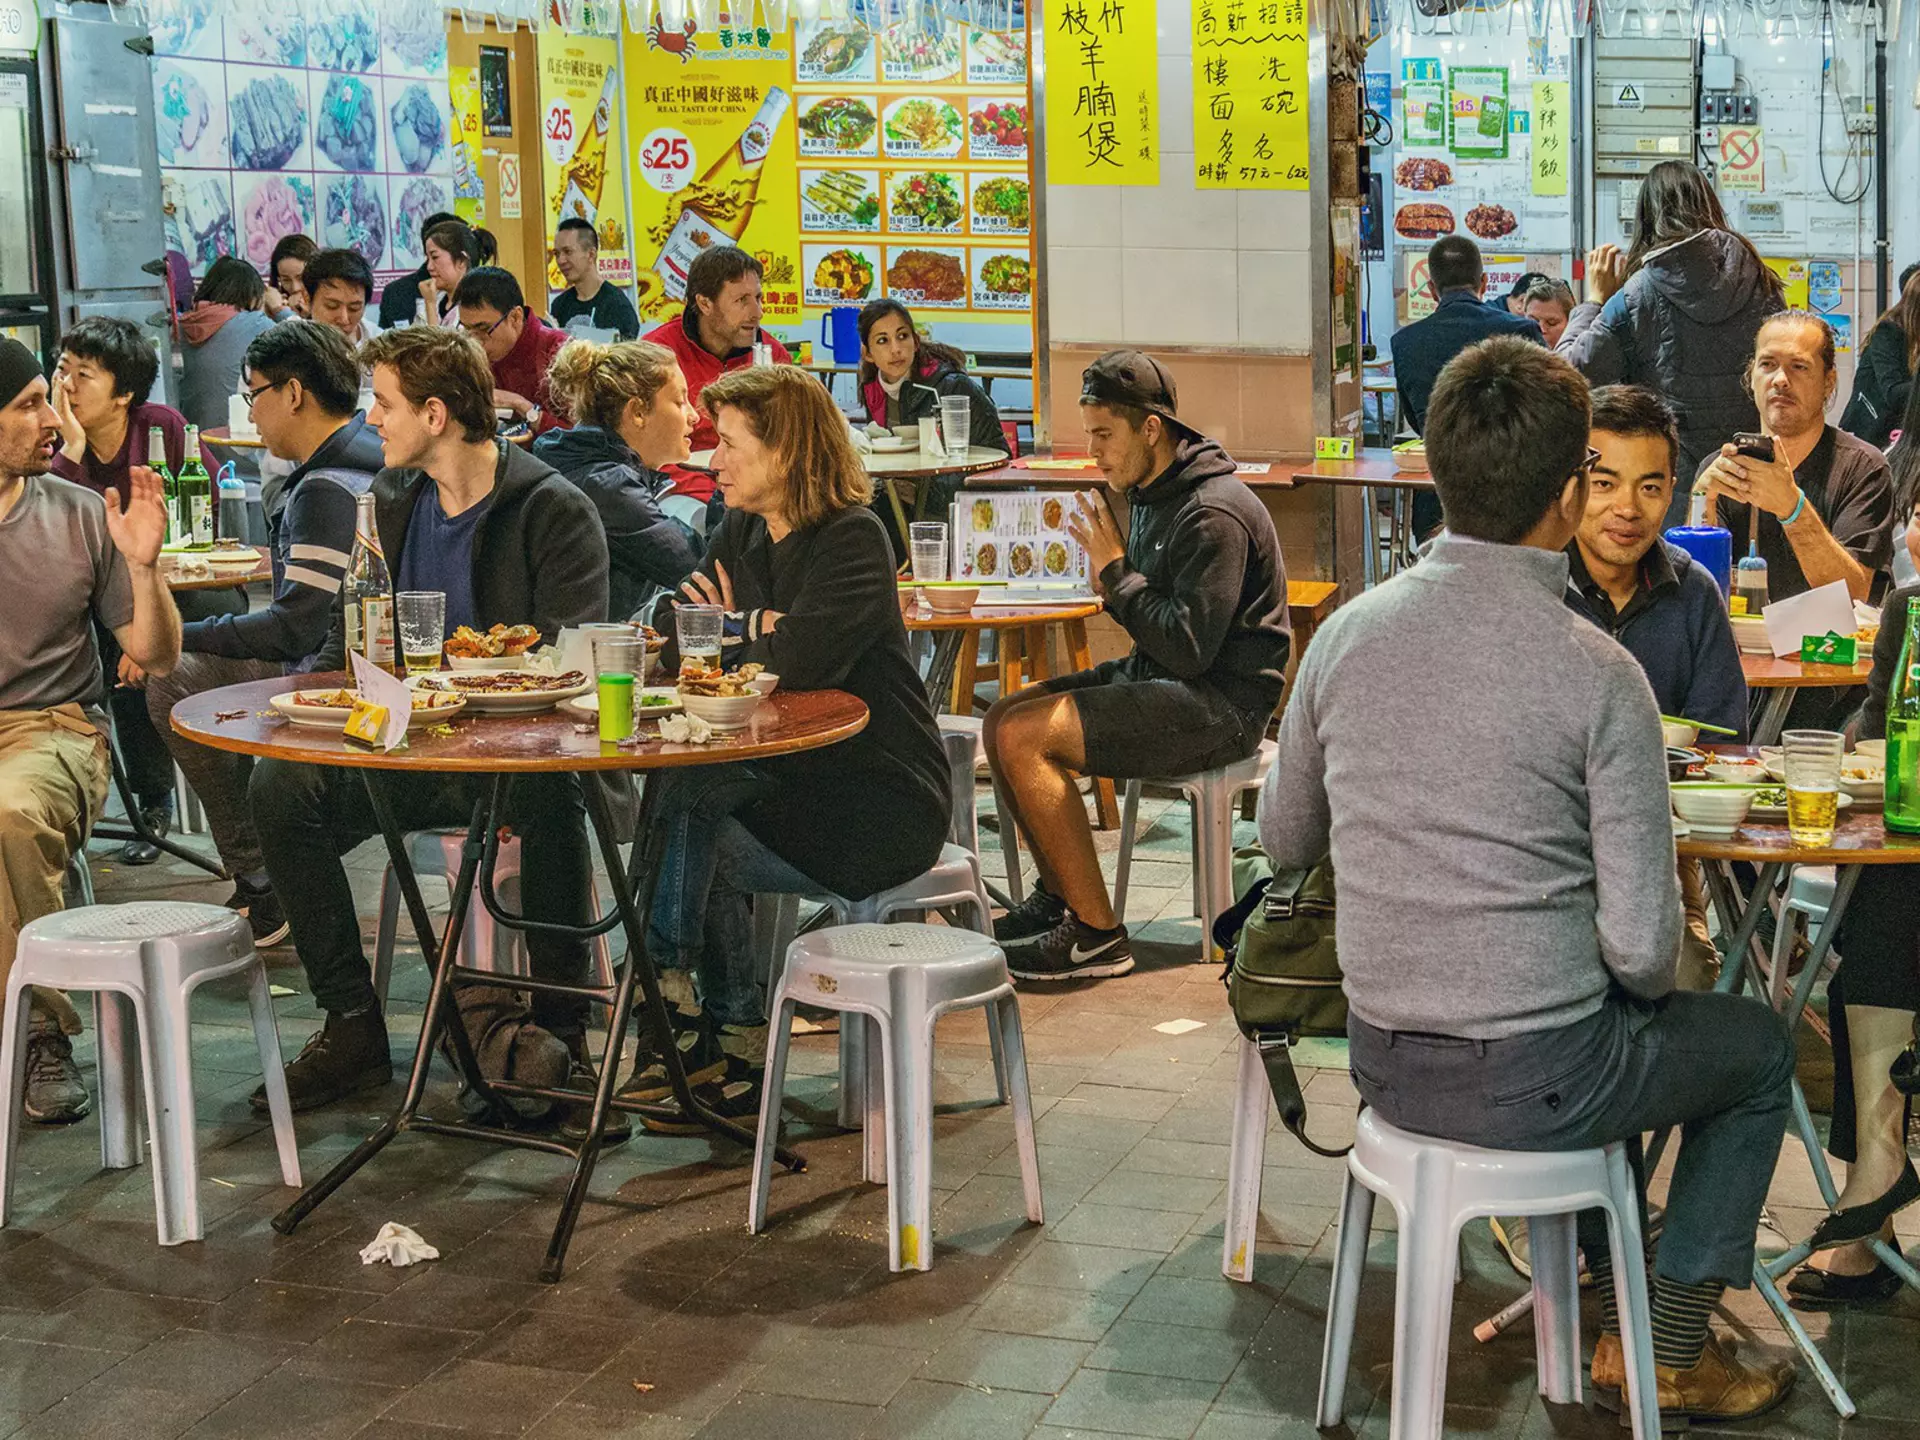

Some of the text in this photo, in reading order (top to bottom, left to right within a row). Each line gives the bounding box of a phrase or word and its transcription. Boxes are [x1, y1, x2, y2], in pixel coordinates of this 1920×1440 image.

[644, 85, 759, 104] 真正中國好滋味
[1074, 35, 1124, 168] 羊腩煲
[1258, 55, 1299, 115] 洗碗
[546, 106, 573, 141] $25
[657, 105, 747, 113] REAL TASTE OF CHINA
[642, 137, 690, 170] $25
[774, 306, 798, 314] BEER
